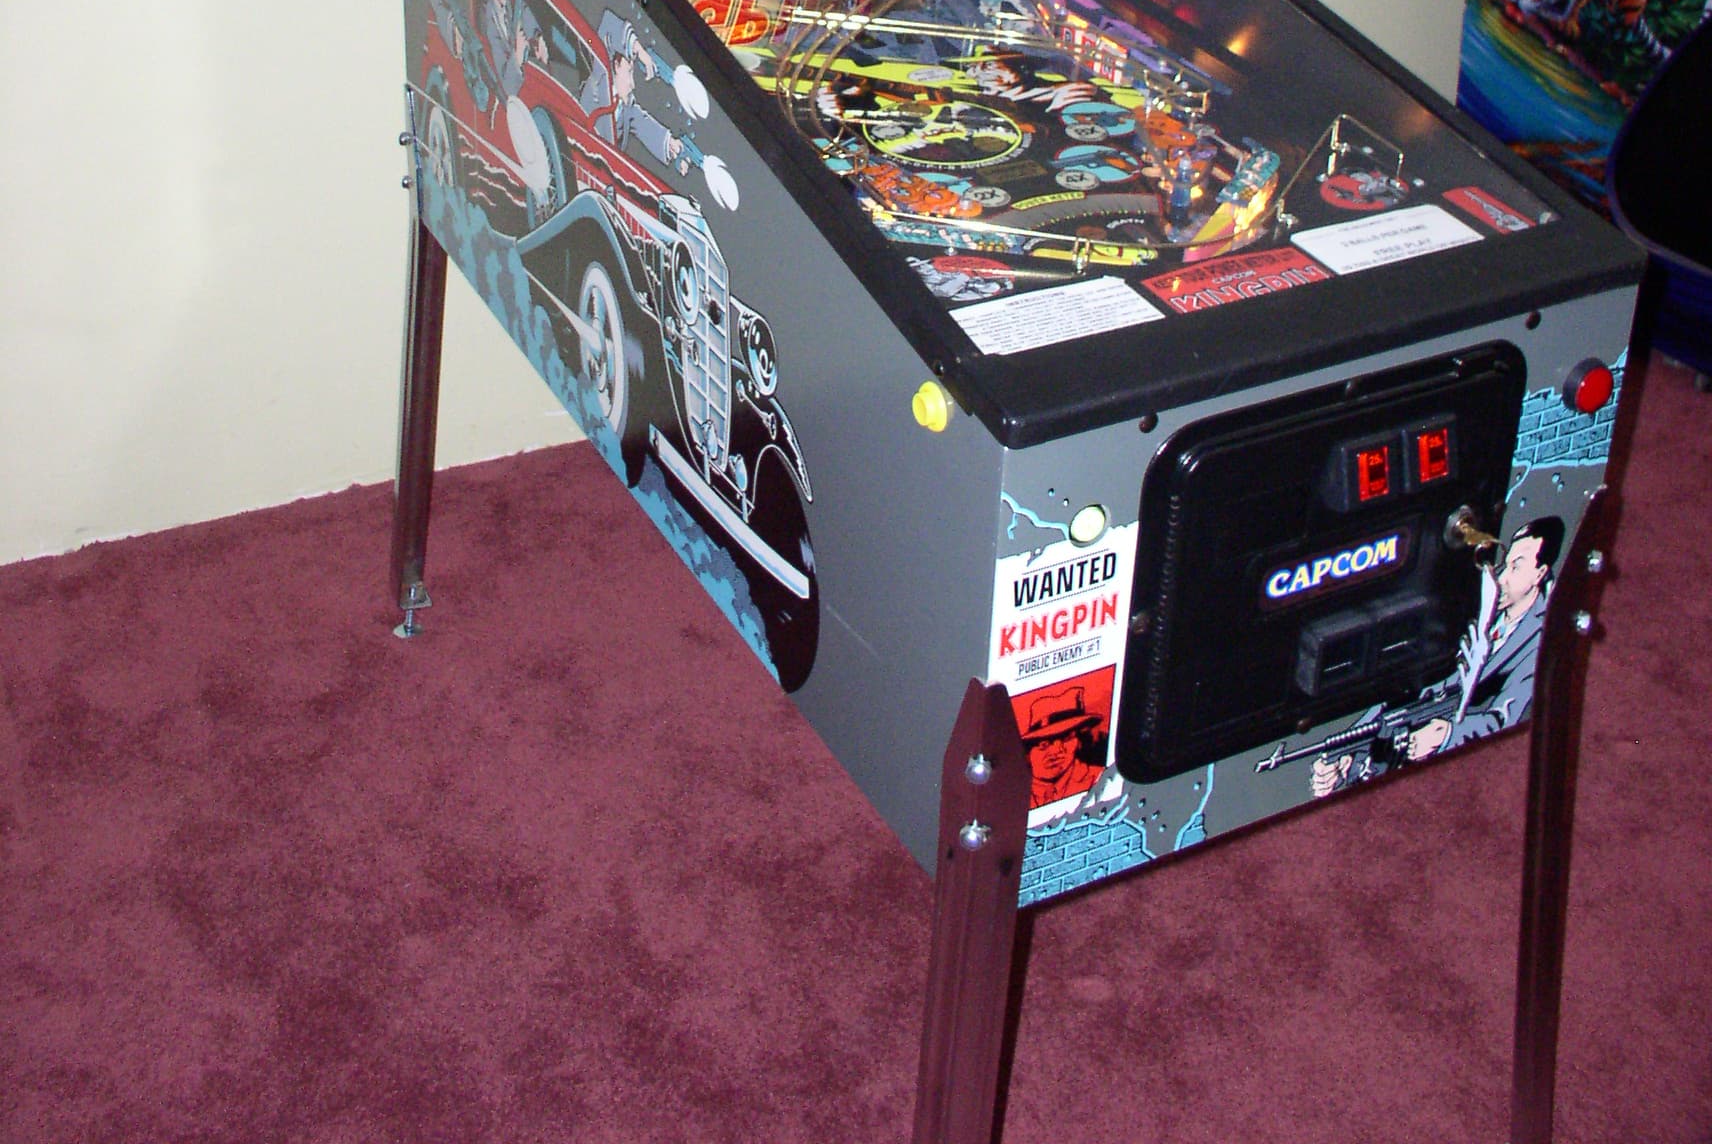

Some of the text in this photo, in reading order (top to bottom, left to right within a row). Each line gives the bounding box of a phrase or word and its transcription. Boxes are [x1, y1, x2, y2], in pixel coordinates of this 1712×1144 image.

[1013, 552, 1117, 608] WANTED
[1266, 534, 1398, 598] CAPCOM
[999, 593, 1119, 658] KINGPIN
[1018, 639, 1100, 675] PUBLIC ENEMY #1
